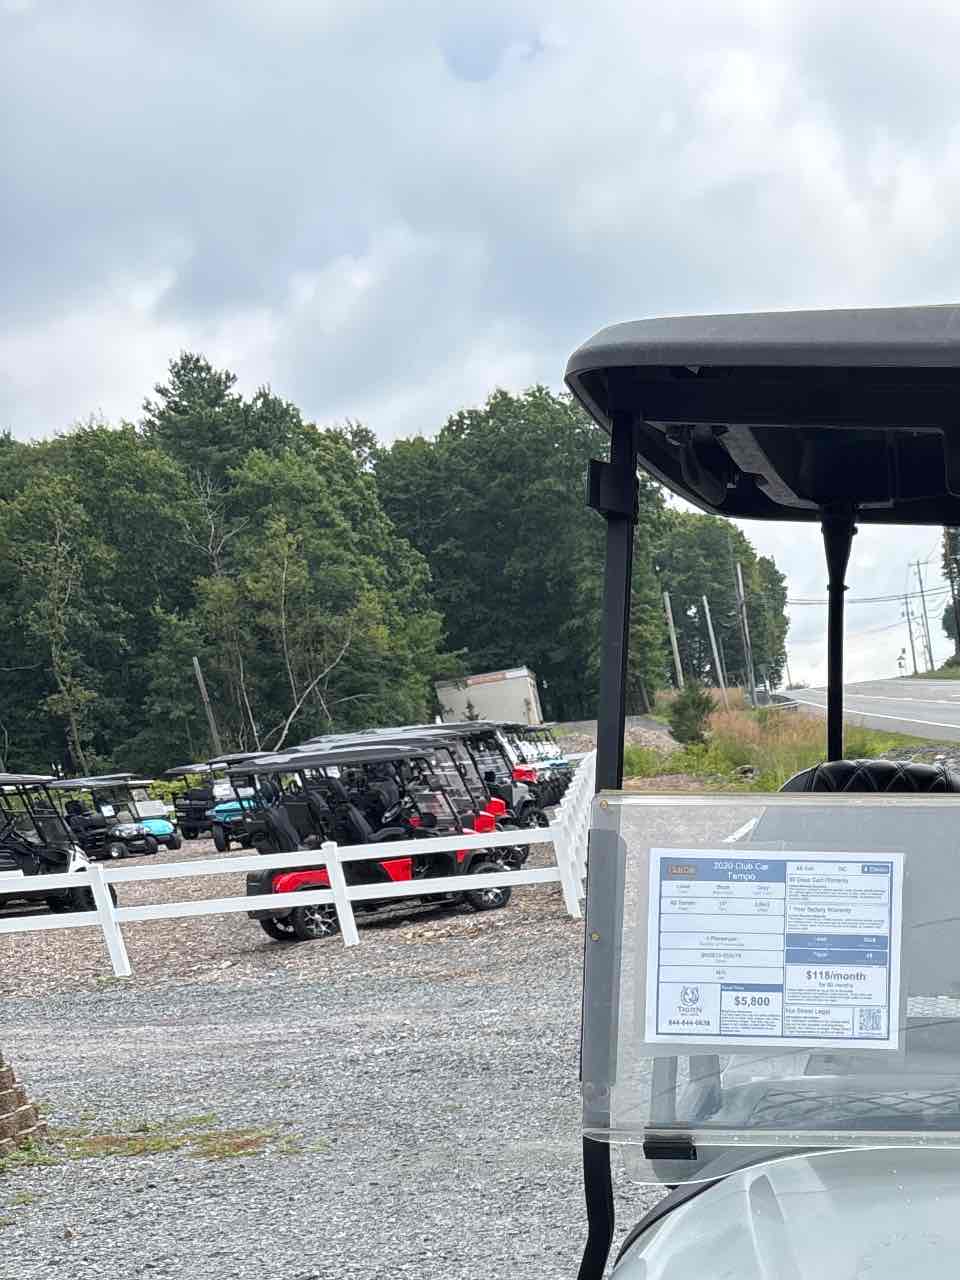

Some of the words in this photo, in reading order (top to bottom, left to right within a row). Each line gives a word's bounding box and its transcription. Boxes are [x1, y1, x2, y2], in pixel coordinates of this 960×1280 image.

[735, 862, 753, 871] Club
[727, 871, 757, 881] Tempo
[734, 995, 770, 1008] $5,800
